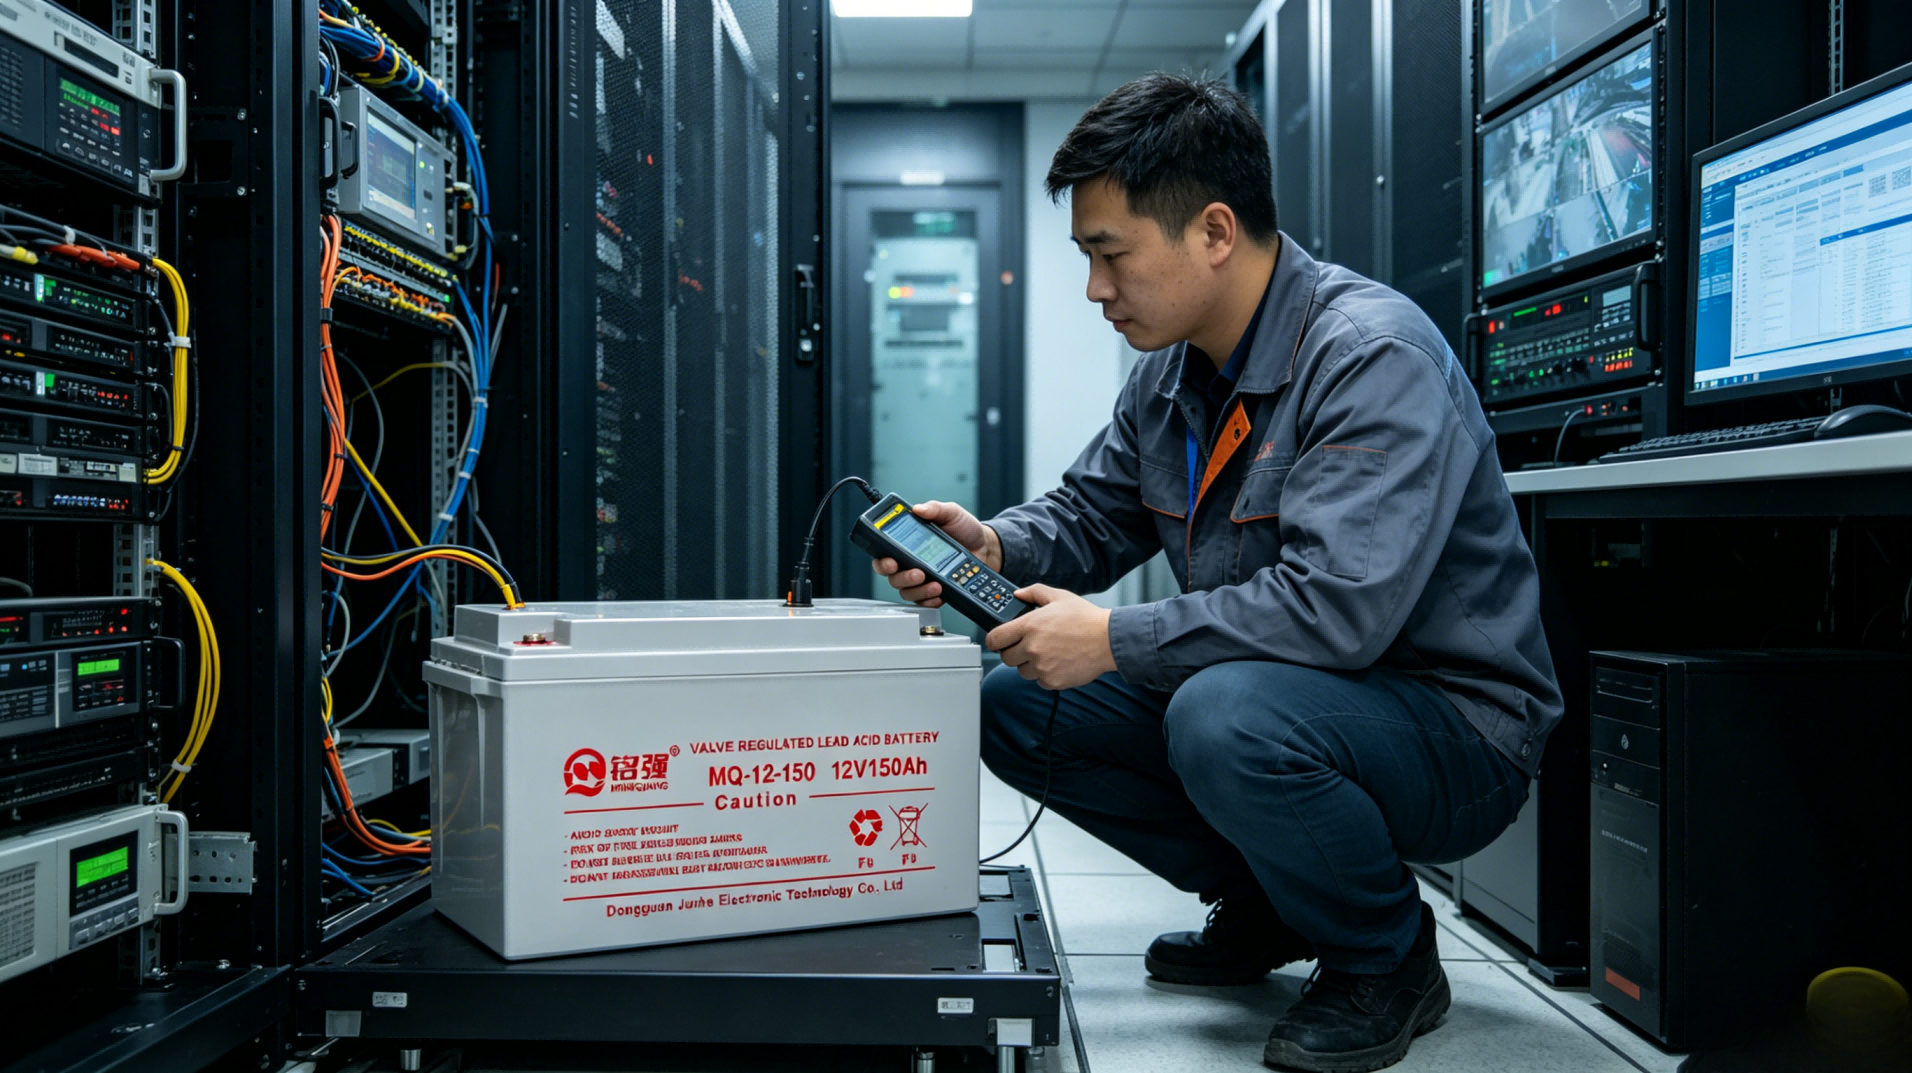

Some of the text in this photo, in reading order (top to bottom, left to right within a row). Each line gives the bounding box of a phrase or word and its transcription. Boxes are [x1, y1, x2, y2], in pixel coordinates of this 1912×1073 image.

[689, 731, 940, 755] VALVE REGULATED LEAD ACID BATTERY
[708, 756, 928, 787] MQ-12-150 12V150Ah
[714, 791, 797, 811] Caution
[605, 901, 674, 918] Dongguan
